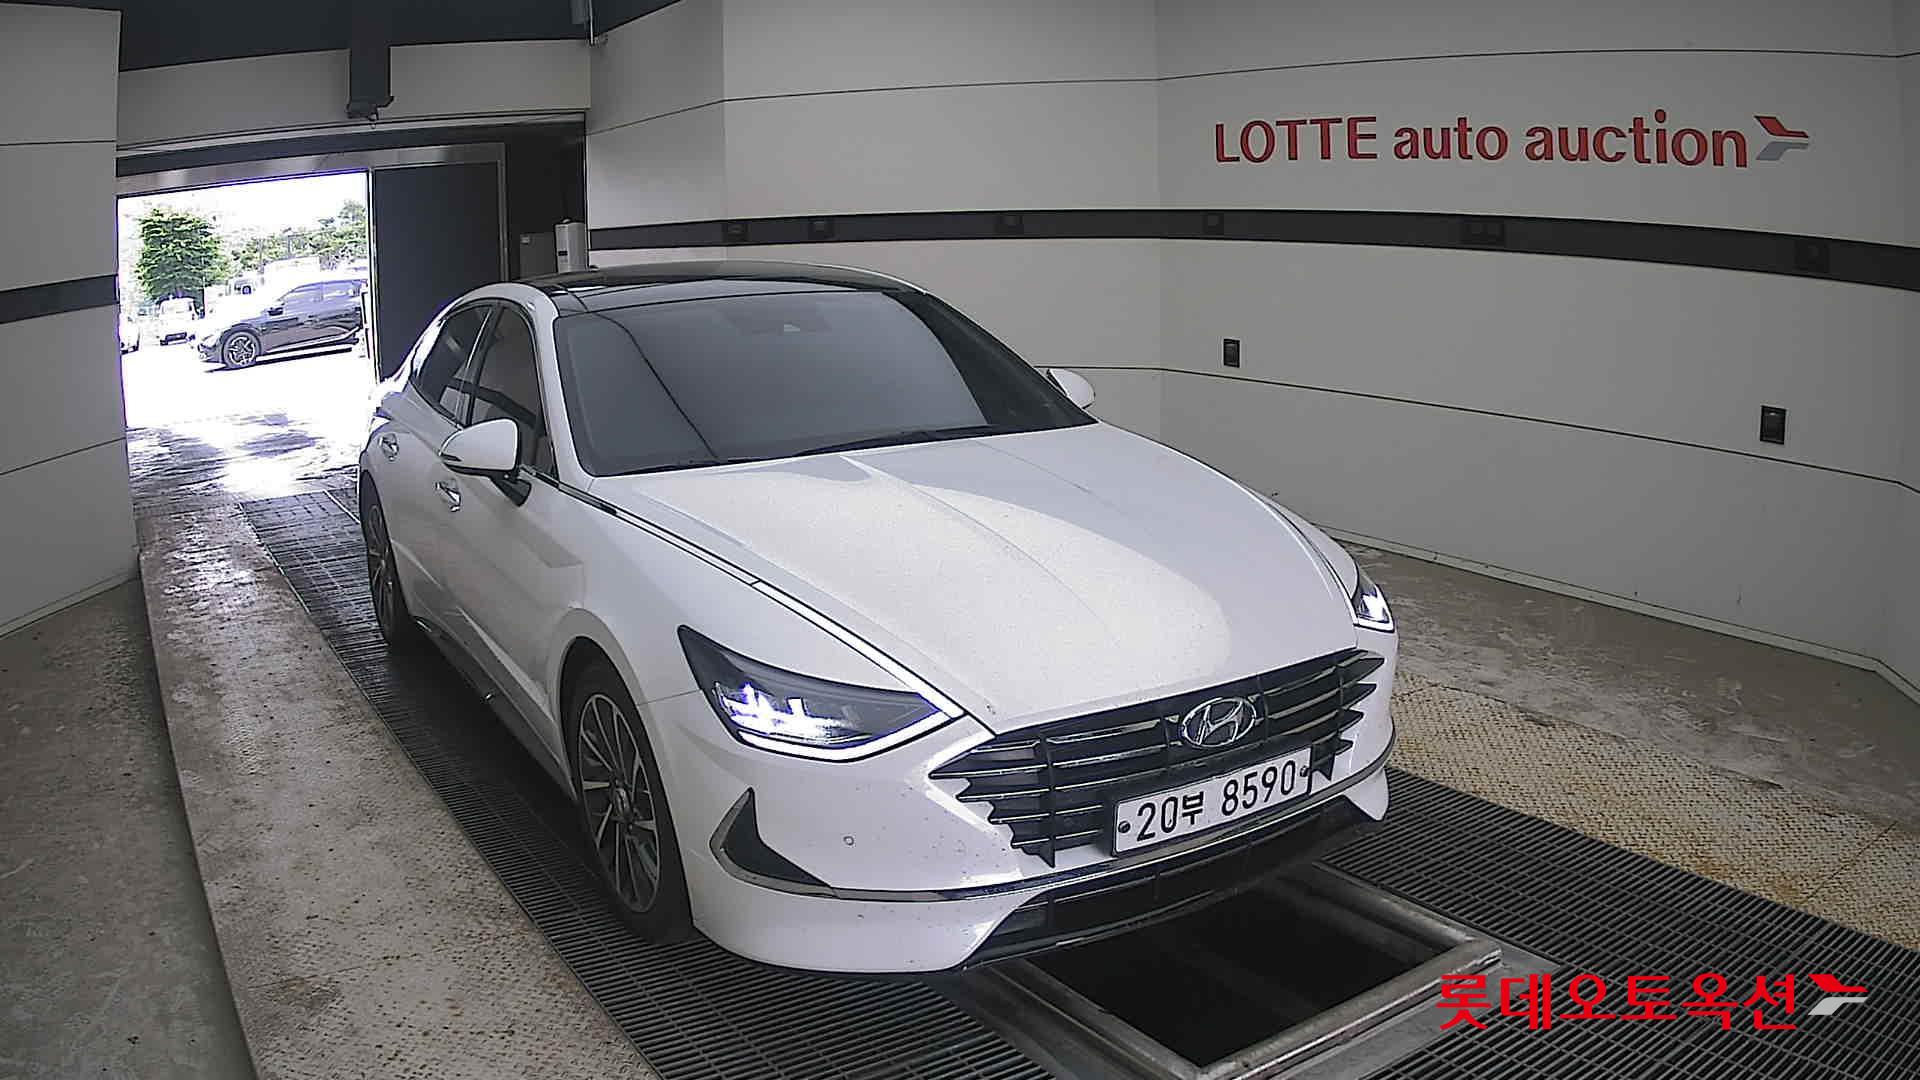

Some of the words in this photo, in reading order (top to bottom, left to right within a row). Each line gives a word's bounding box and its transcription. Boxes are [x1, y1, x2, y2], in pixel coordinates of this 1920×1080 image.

[1215, 116, 1378, 164] LOTTE
[1393, 116, 1509, 161] auto
[1525, 109, 1748, 169] auction
[1136, 791, 1204, 842] 20부
[1221, 760, 1297, 816] 8590
